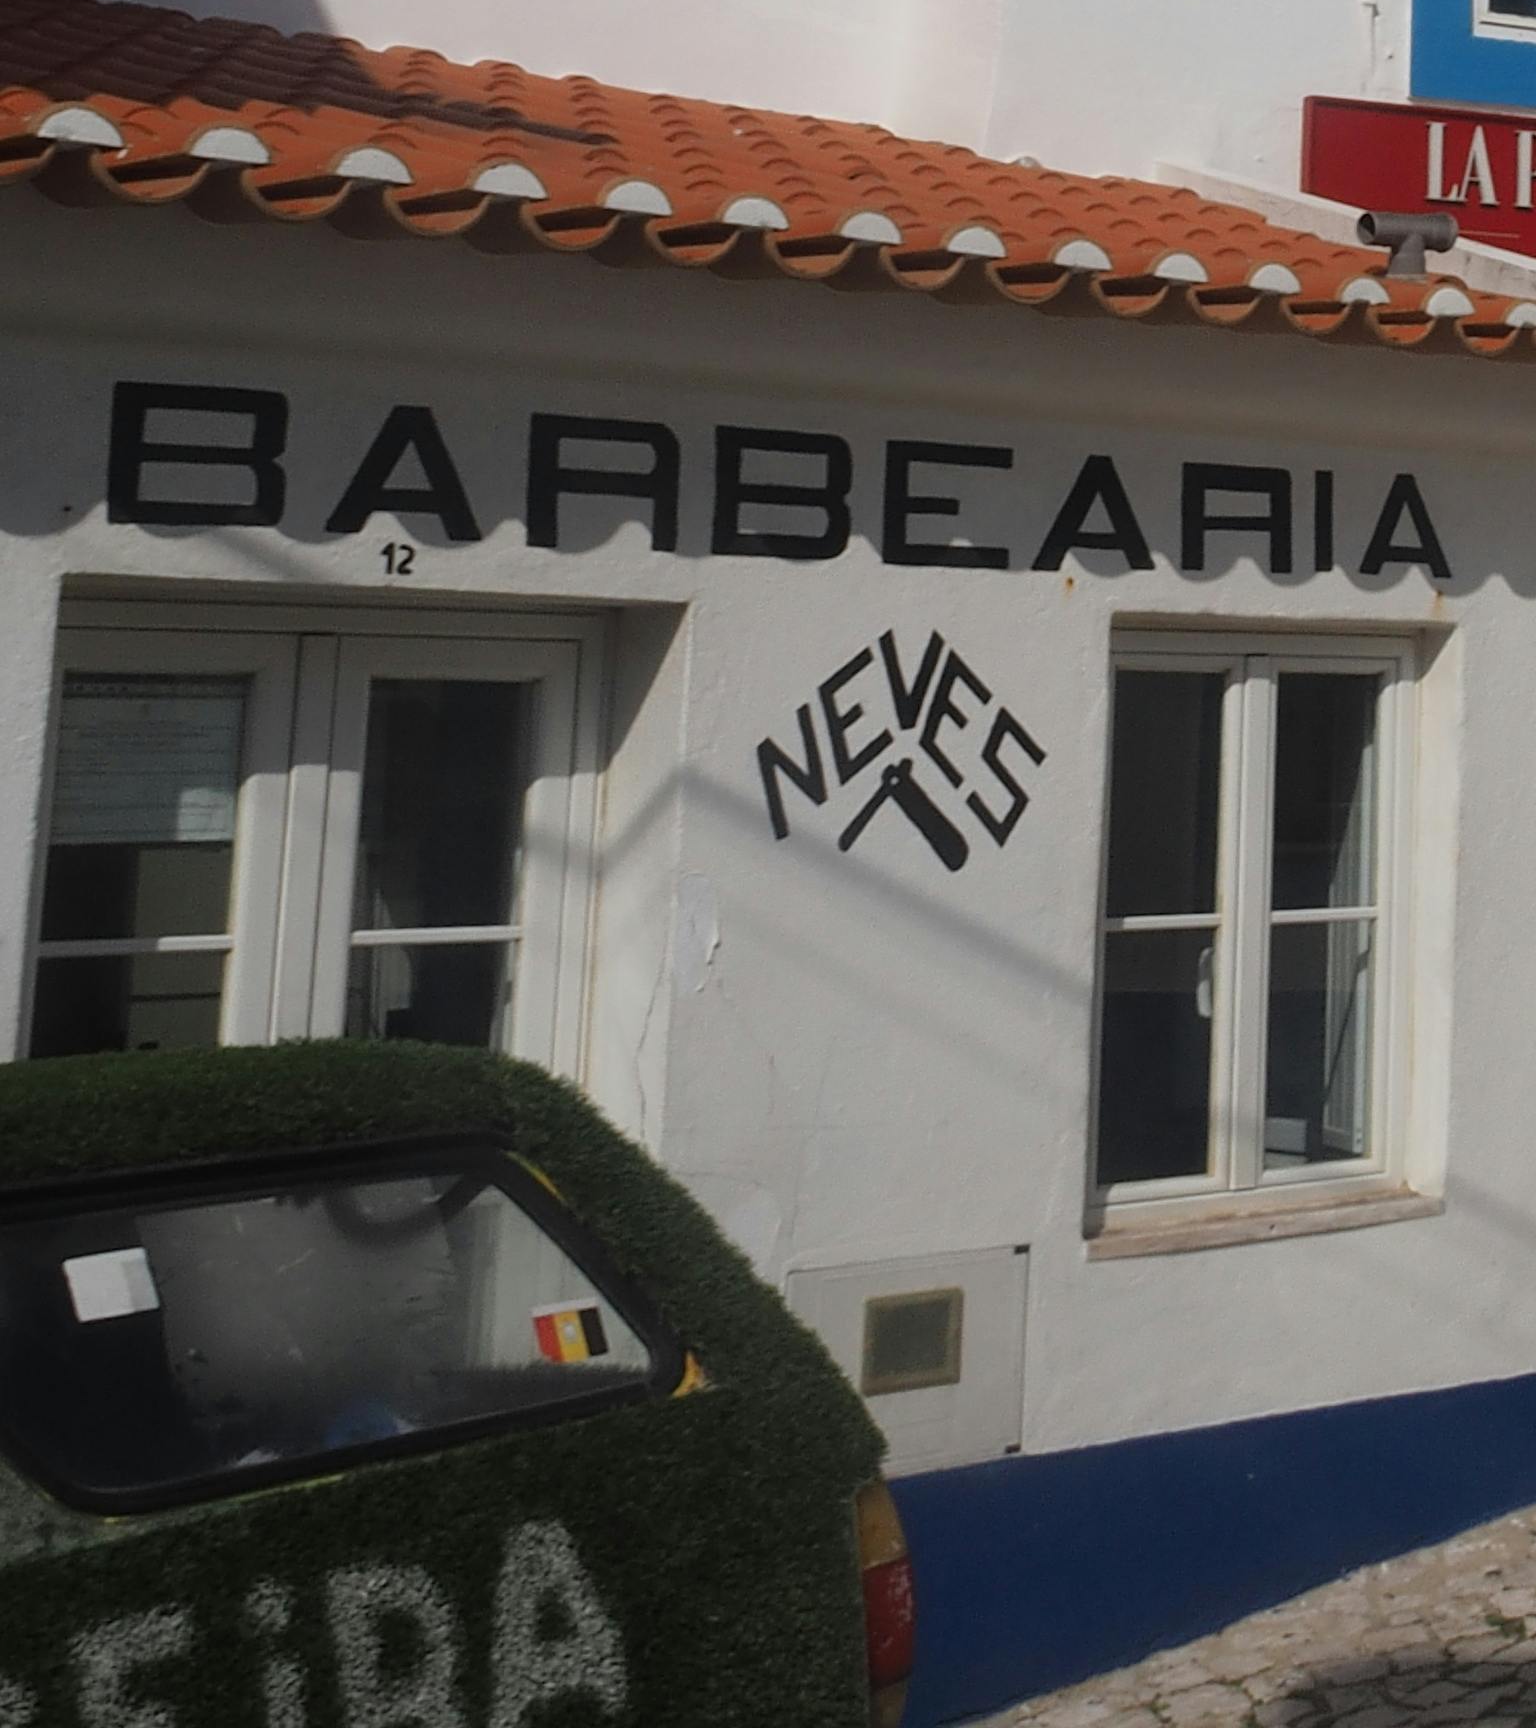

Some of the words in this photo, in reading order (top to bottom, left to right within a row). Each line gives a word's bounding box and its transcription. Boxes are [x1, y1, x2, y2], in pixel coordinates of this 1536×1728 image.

[1425, 122, 1500, 206] LA
[105, 381, 1453, 578] BARBEARIA
[380, 542, 416, 575] 12
[756, 629, 1046, 847] NEVES
